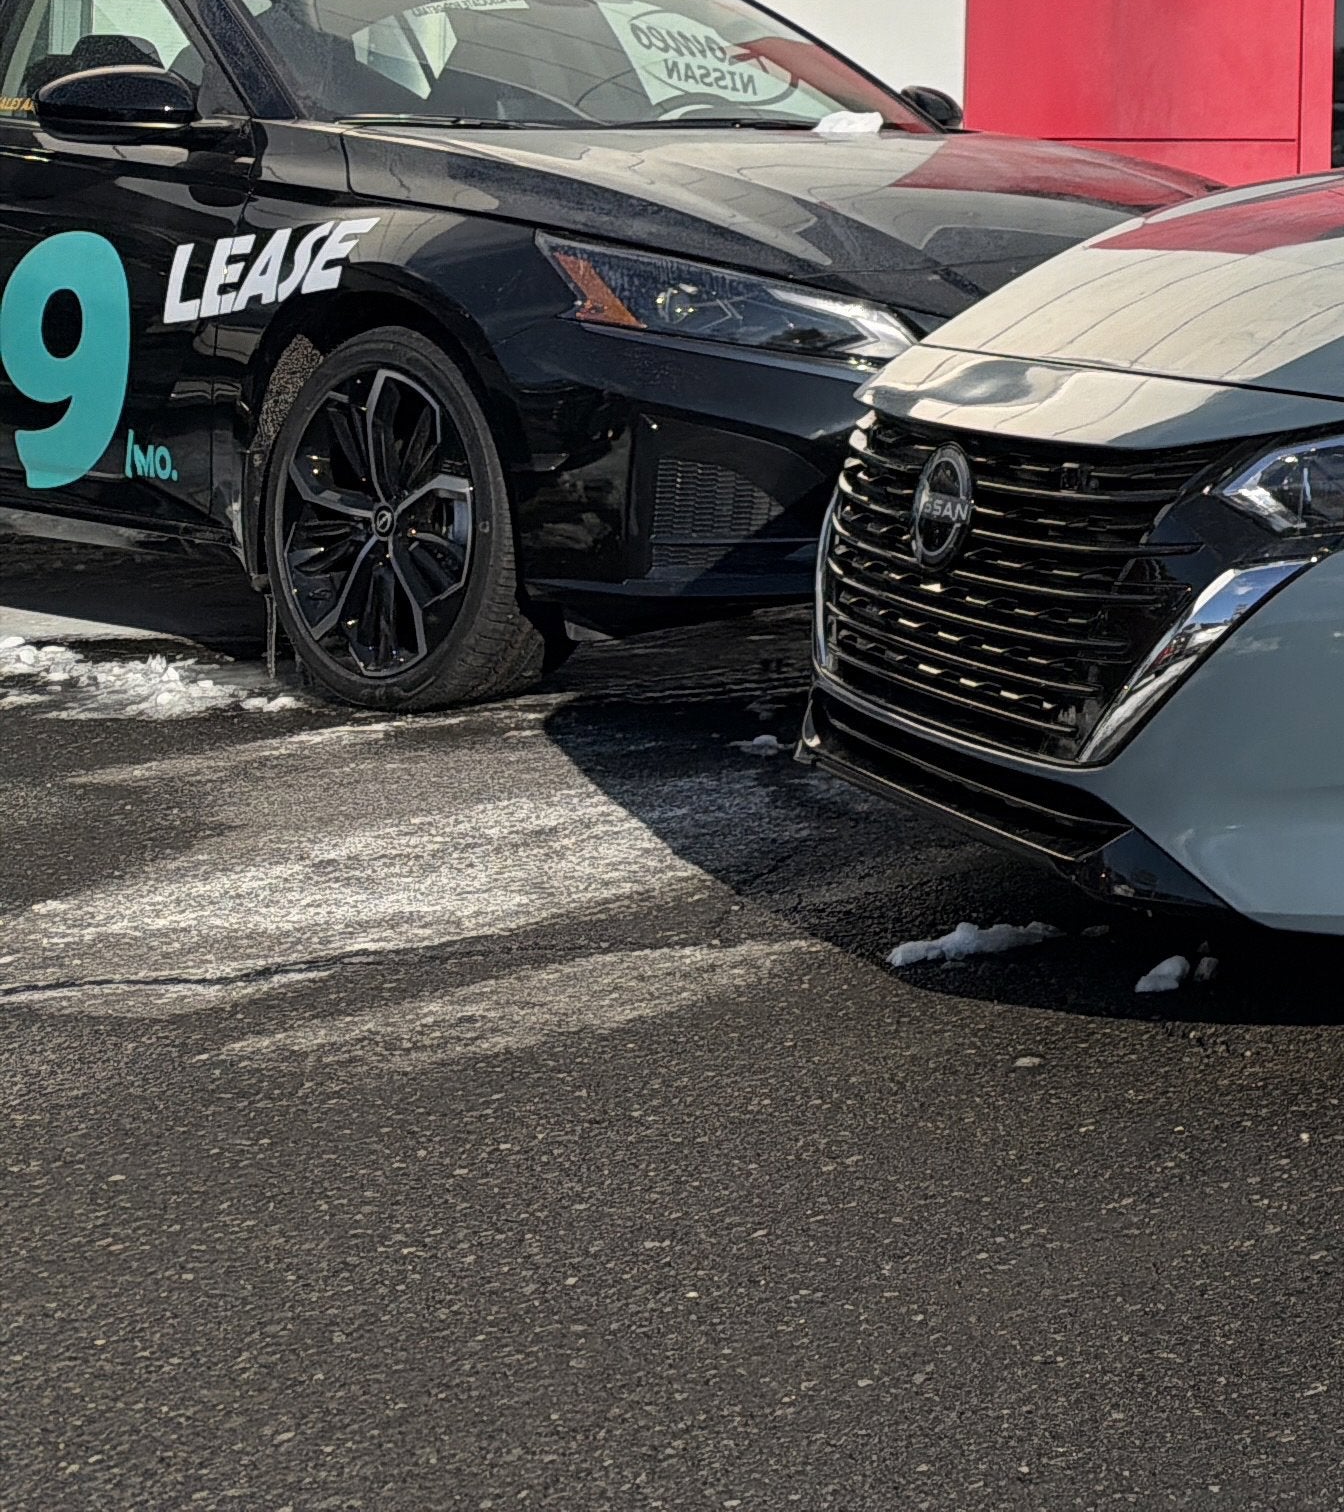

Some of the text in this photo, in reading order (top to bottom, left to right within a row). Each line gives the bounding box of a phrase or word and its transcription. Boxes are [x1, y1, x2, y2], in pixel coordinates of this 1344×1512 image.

[0, 230, 179, 488] 9 /MO.
[163, 217, 381, 324] LEASE
